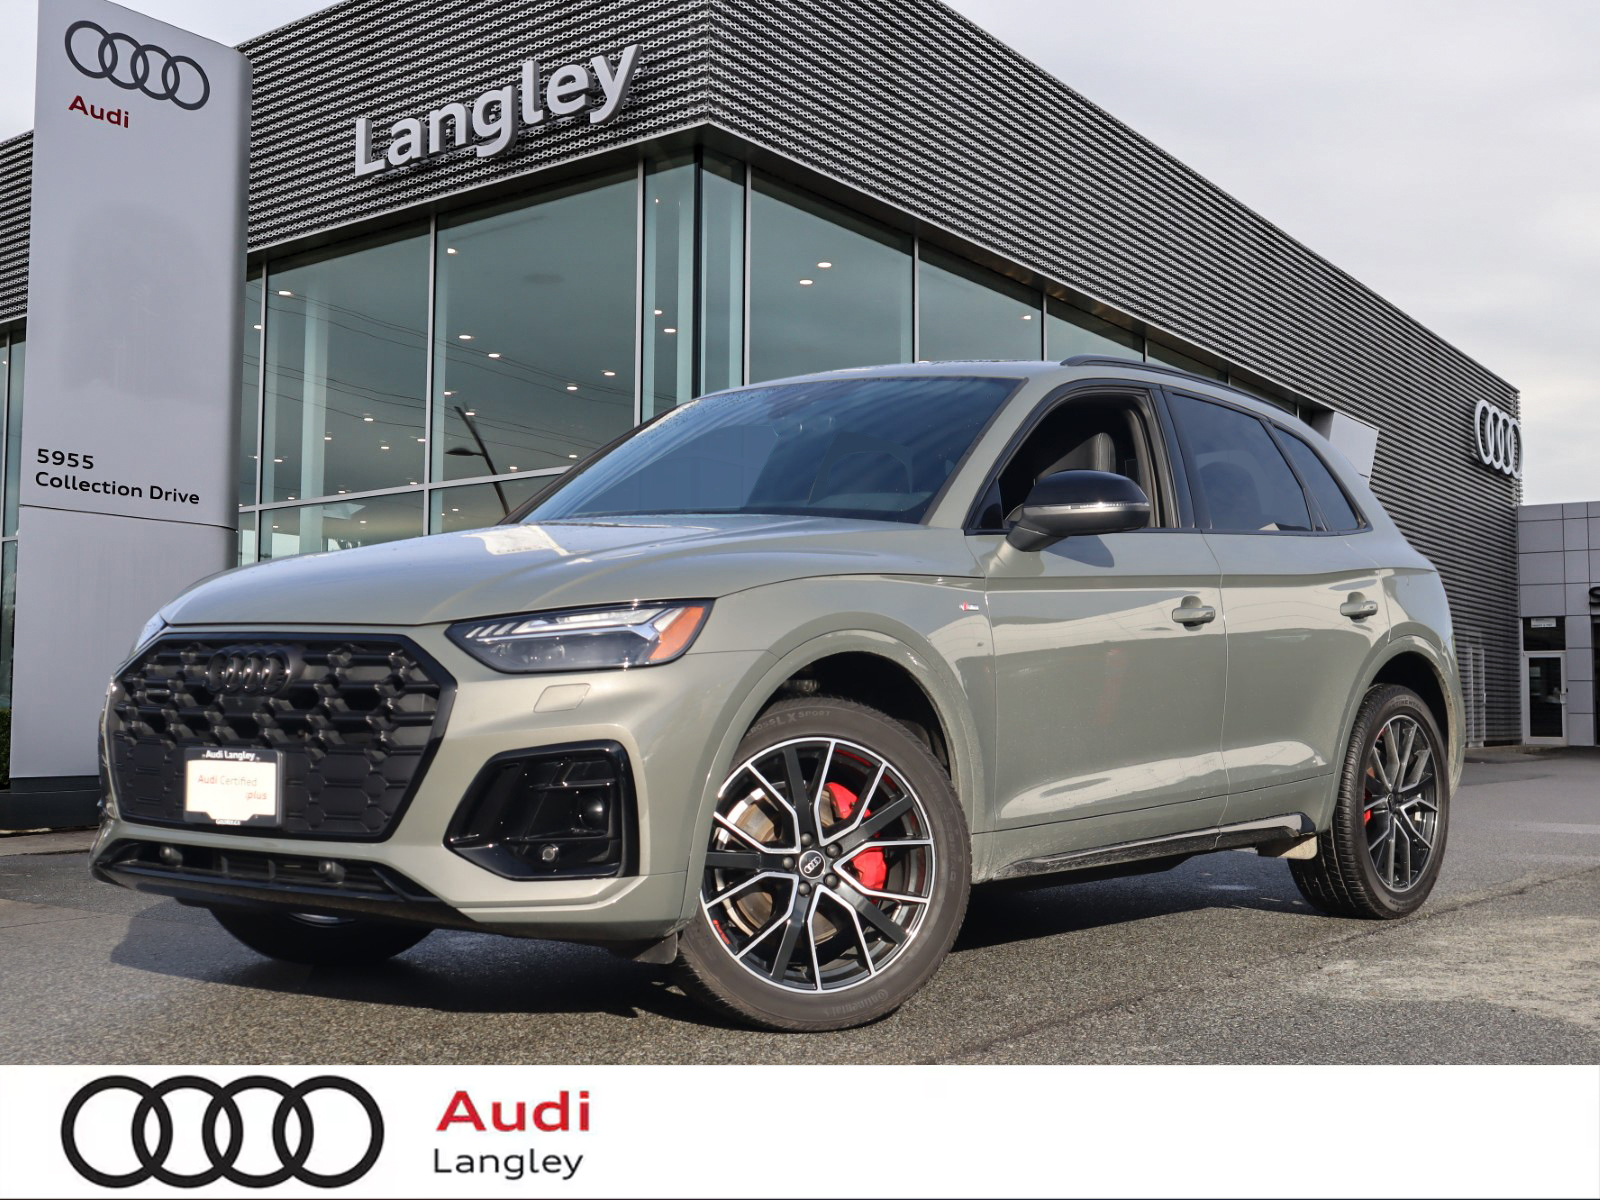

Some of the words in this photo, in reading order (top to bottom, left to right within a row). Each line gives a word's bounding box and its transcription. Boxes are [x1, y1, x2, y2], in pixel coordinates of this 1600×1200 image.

[69, 96, 128, 128] Audi
[354, 43, 641, 177] Langley
[36, 448, 95, 470] 5955
[35, 471, 143, 498] Collection
[149, 485, 200, 505] Drive
[206, 749, 223, 758] Audi
[224, 751, 255, 761] Langley
[198, 775, 218, 785] Audi
[219, 776, 257, 787] Certified
